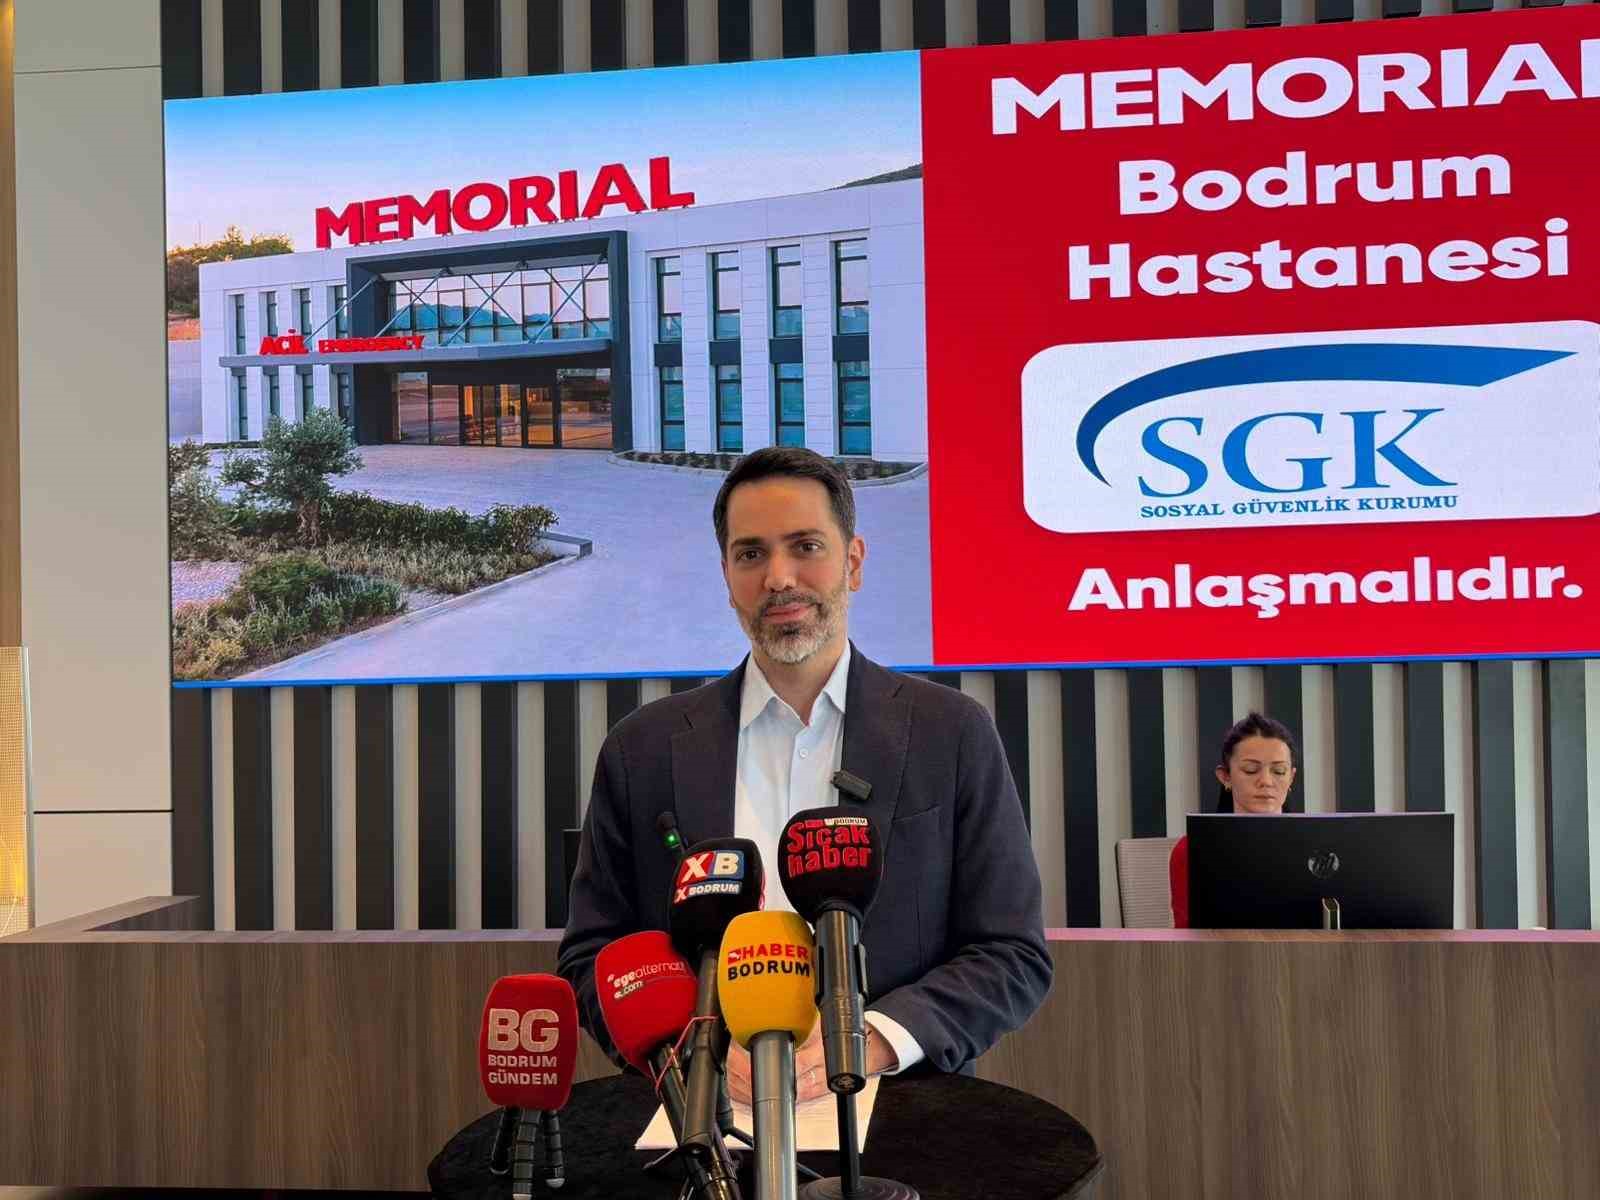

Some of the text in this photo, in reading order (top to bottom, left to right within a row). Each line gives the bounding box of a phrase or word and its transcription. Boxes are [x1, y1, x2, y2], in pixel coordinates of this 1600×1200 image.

[1119, 151, 1512, 216] Bodrum
[315, 156, 695, 249] MEMORIAL
[1068, 218, 1569, 300] Hastanesi
[1138, 408, 1458, 498] SGK
[1140, 495, 1458, 518] SOSYAL GÜVENLİK KURUMU
[1067, 556, 1584, 619] Anlaşmalıdır.
[680, 852, 740, 884] XB
[787, 843, 871, 878] haber
[673, 883, 740, 904] X BODRUM
[742, 943, 809, 962] HABER
[727, 960, 811, 981] BODRUM
[487, 1007, 560, 1053] BG
[487, 1054, 558, 1068] BODRUM
[487, 1068, 559, 1085] GÜNDEM
